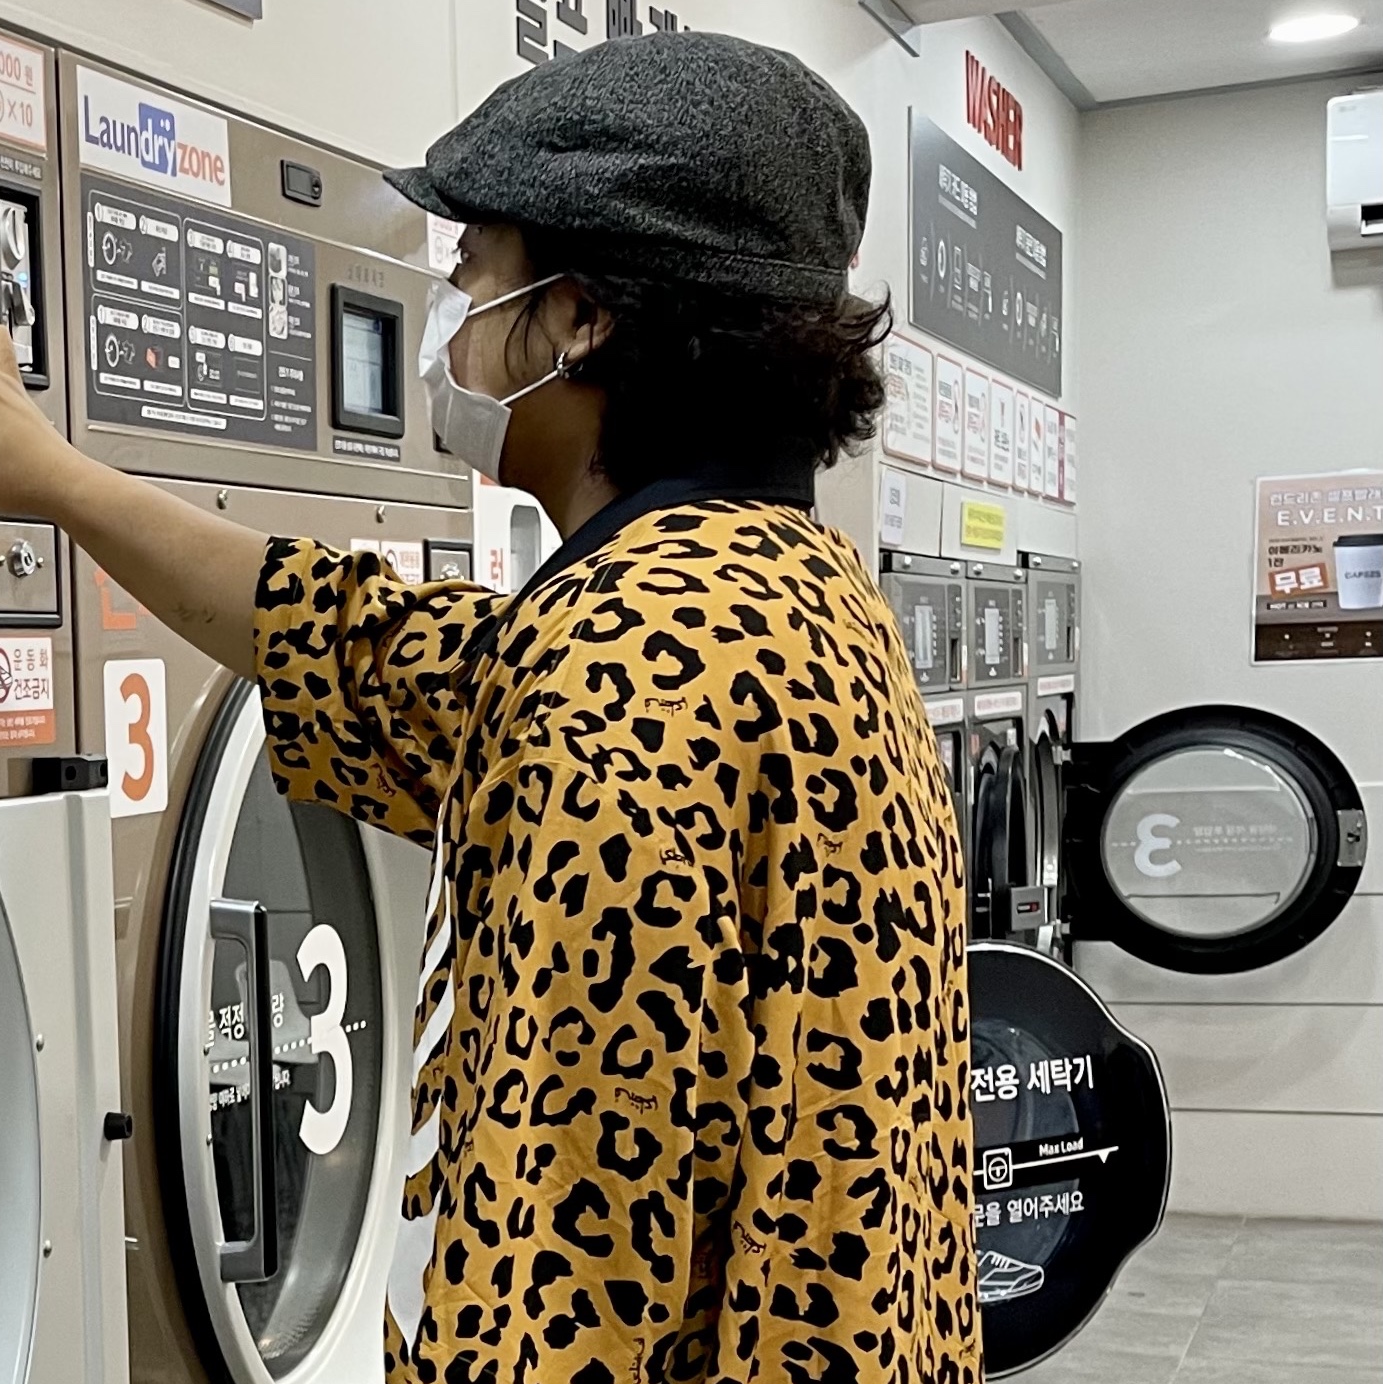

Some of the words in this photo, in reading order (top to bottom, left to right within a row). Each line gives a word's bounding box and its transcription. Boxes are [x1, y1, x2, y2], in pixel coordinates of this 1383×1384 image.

[965, 49, 1023, 172] WASHER
[1274, 566, 1324, 594] 무료
[14, 677, 50, 700] 건조금지
[120, 672, 154, 802] 3
[218, 1002, 245, 1041] 적정
[296, 924, 353, 1155] 3
[970, 1064, 1020, 1103] 전용
[1026, 1054, 1094, 1095] 세탁기
[1038, 1143, 1060, 1158] Max
[1061, 1137, 1084, 1154] Load
[1007, 1190, 1085, 1224] 열어주세요
